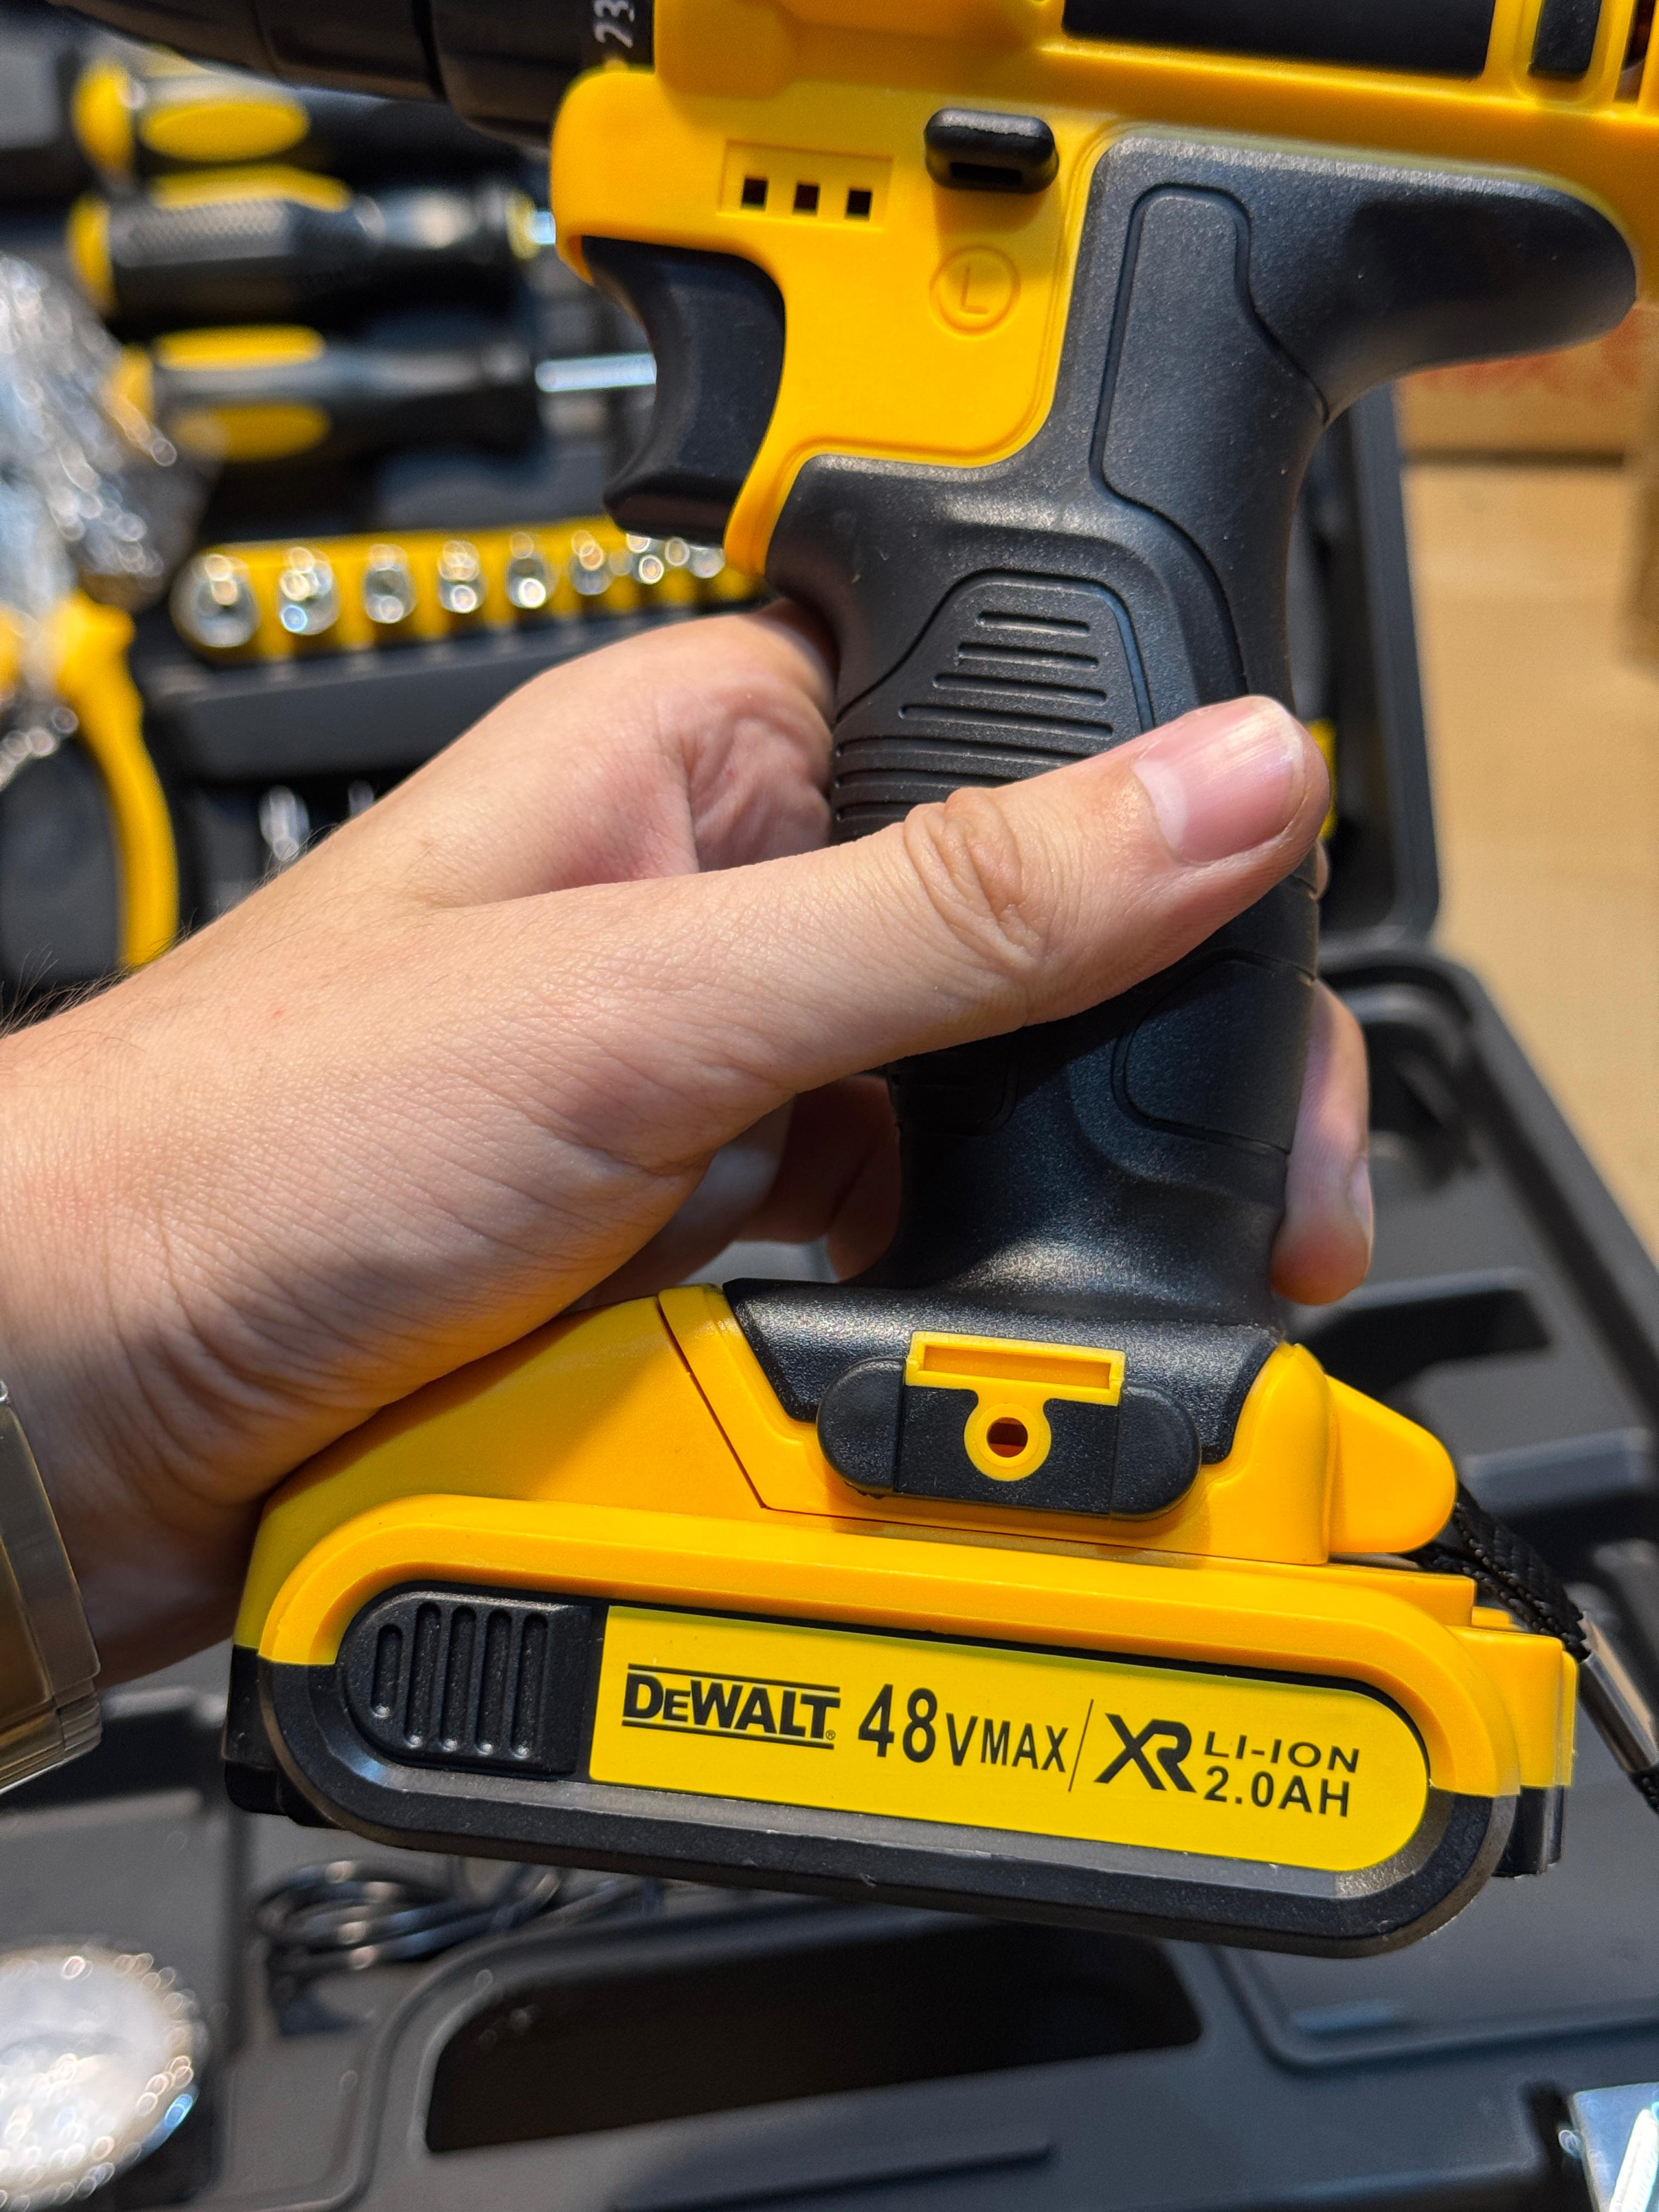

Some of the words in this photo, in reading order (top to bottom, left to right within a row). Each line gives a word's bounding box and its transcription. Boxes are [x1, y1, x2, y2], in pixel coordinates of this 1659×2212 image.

[1093, 1713, 1197, 1793] XR
[1204, 1730, 1359, 1773] LI-ION
[1203, 1765, 1350, 1817] 2.0AH
